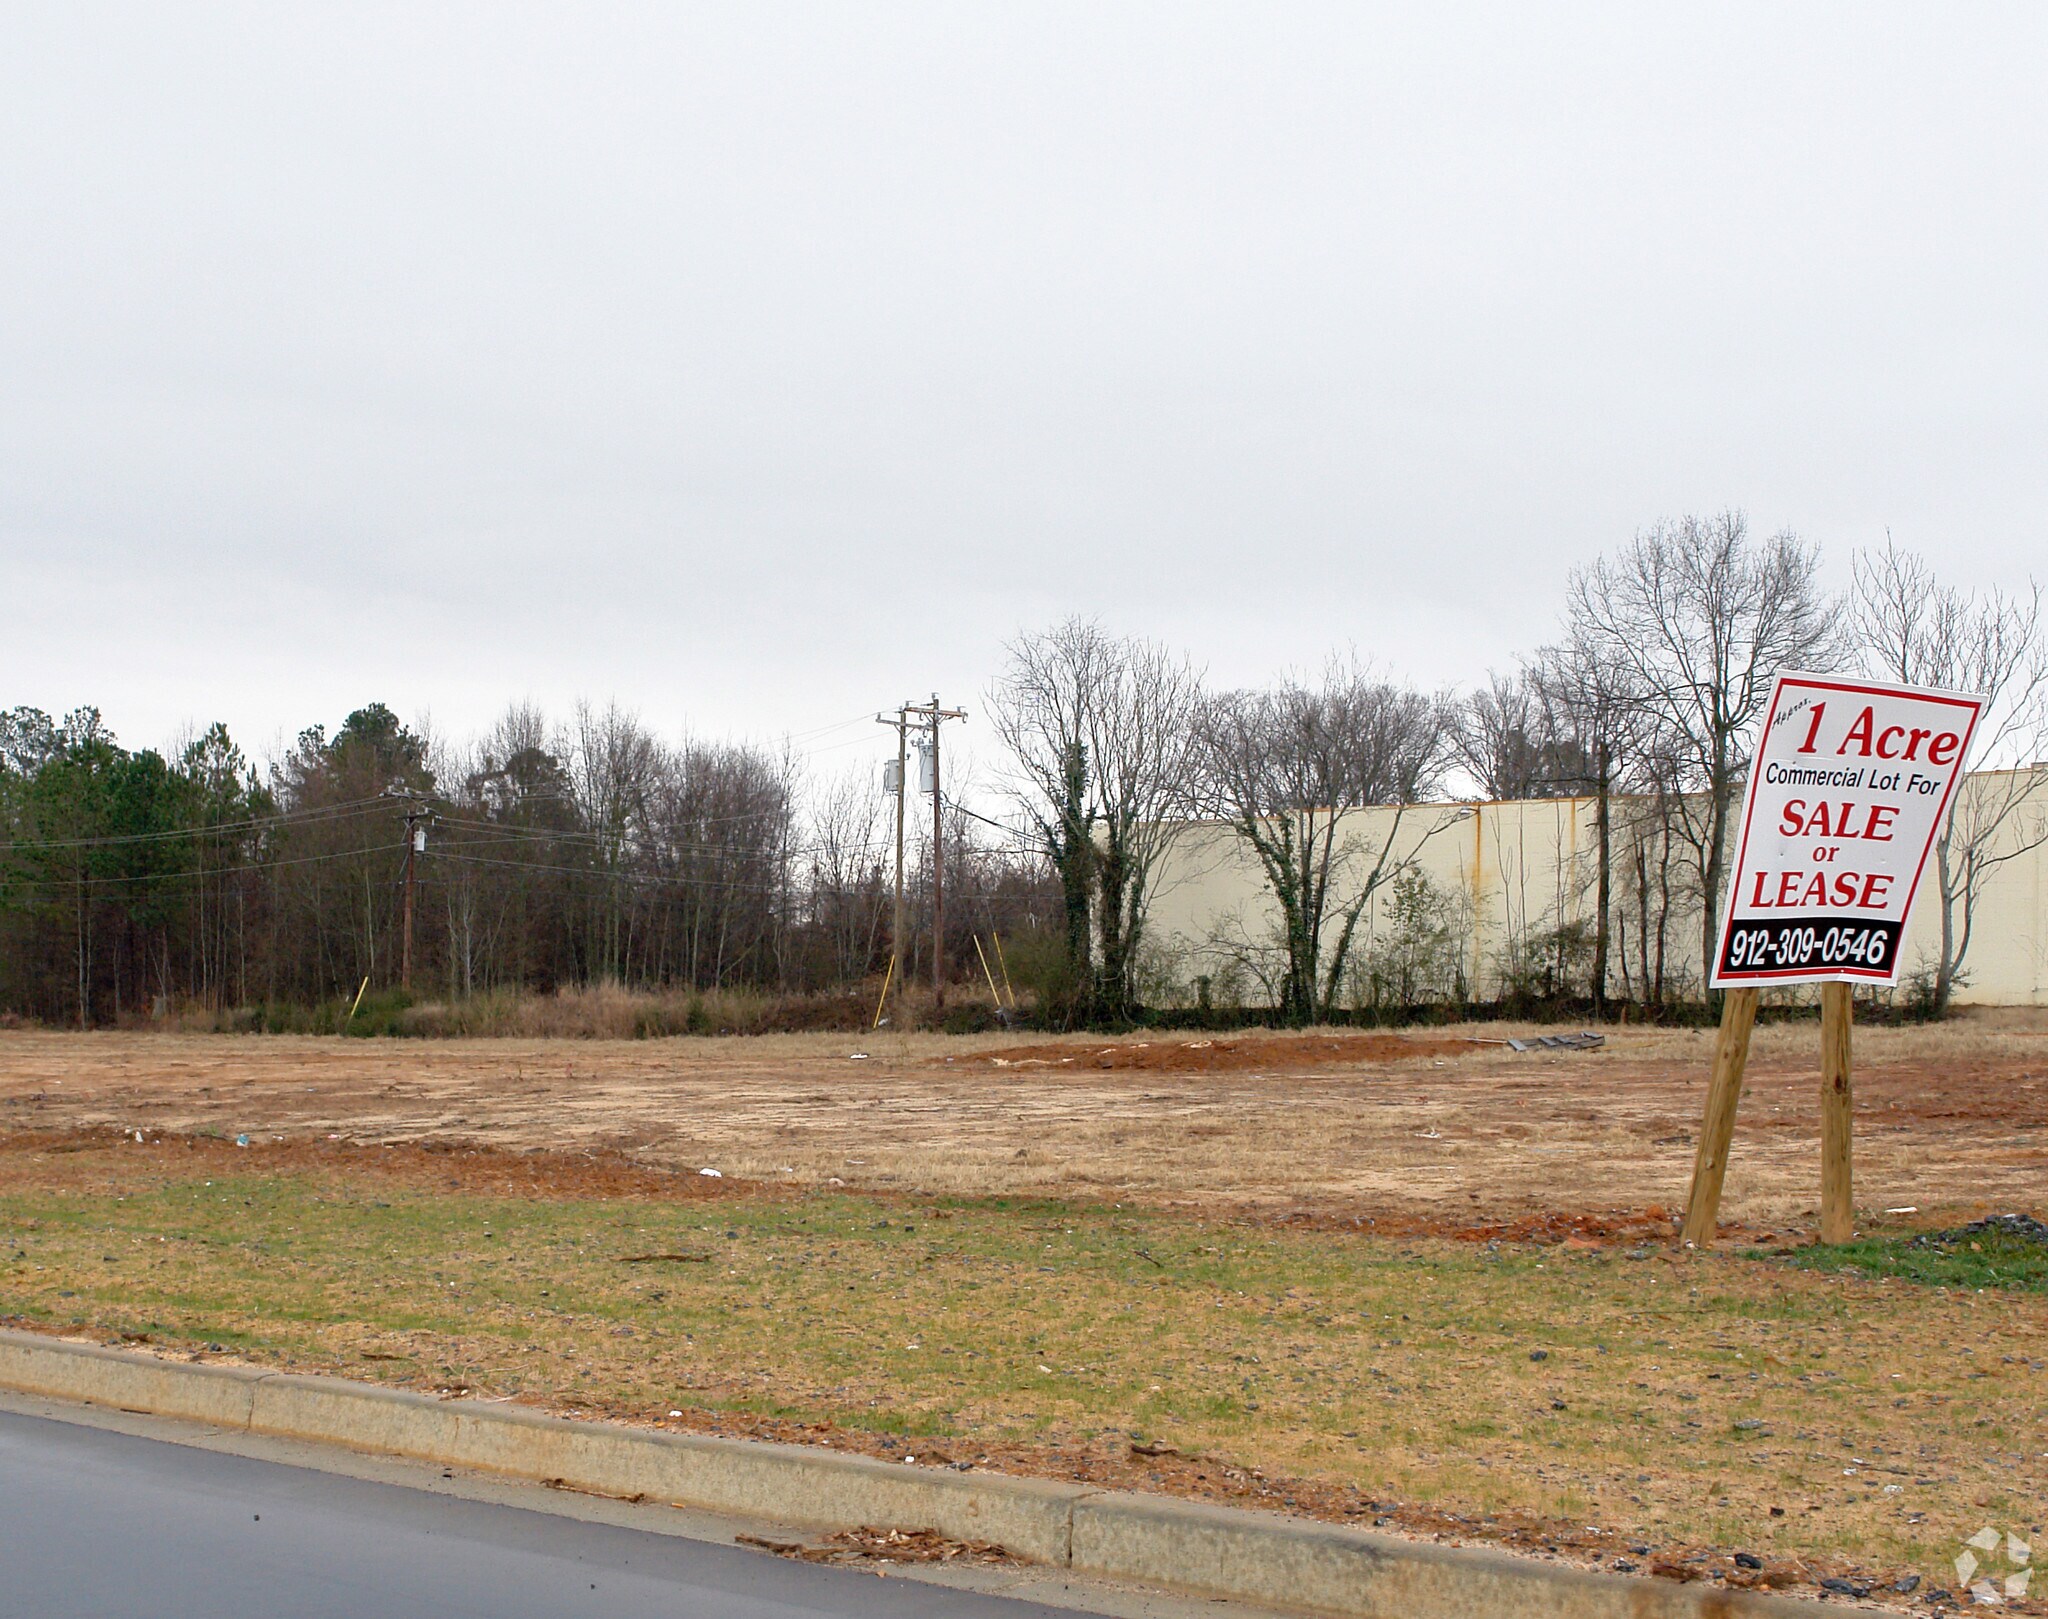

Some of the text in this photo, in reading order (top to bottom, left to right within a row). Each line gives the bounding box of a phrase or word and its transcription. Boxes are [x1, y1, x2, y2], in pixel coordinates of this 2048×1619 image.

[1797, 702, 1960, 765] 1 Acre
[1766, 762, 1941, 796] Commercial Lot For
[1778, 799, 1900, 842] SALE
[1812, 845, 1839, 862] or
[1749, 871, 1894, 909] LEASE
[1730, 927, 1888, 966] 912-309-0546
